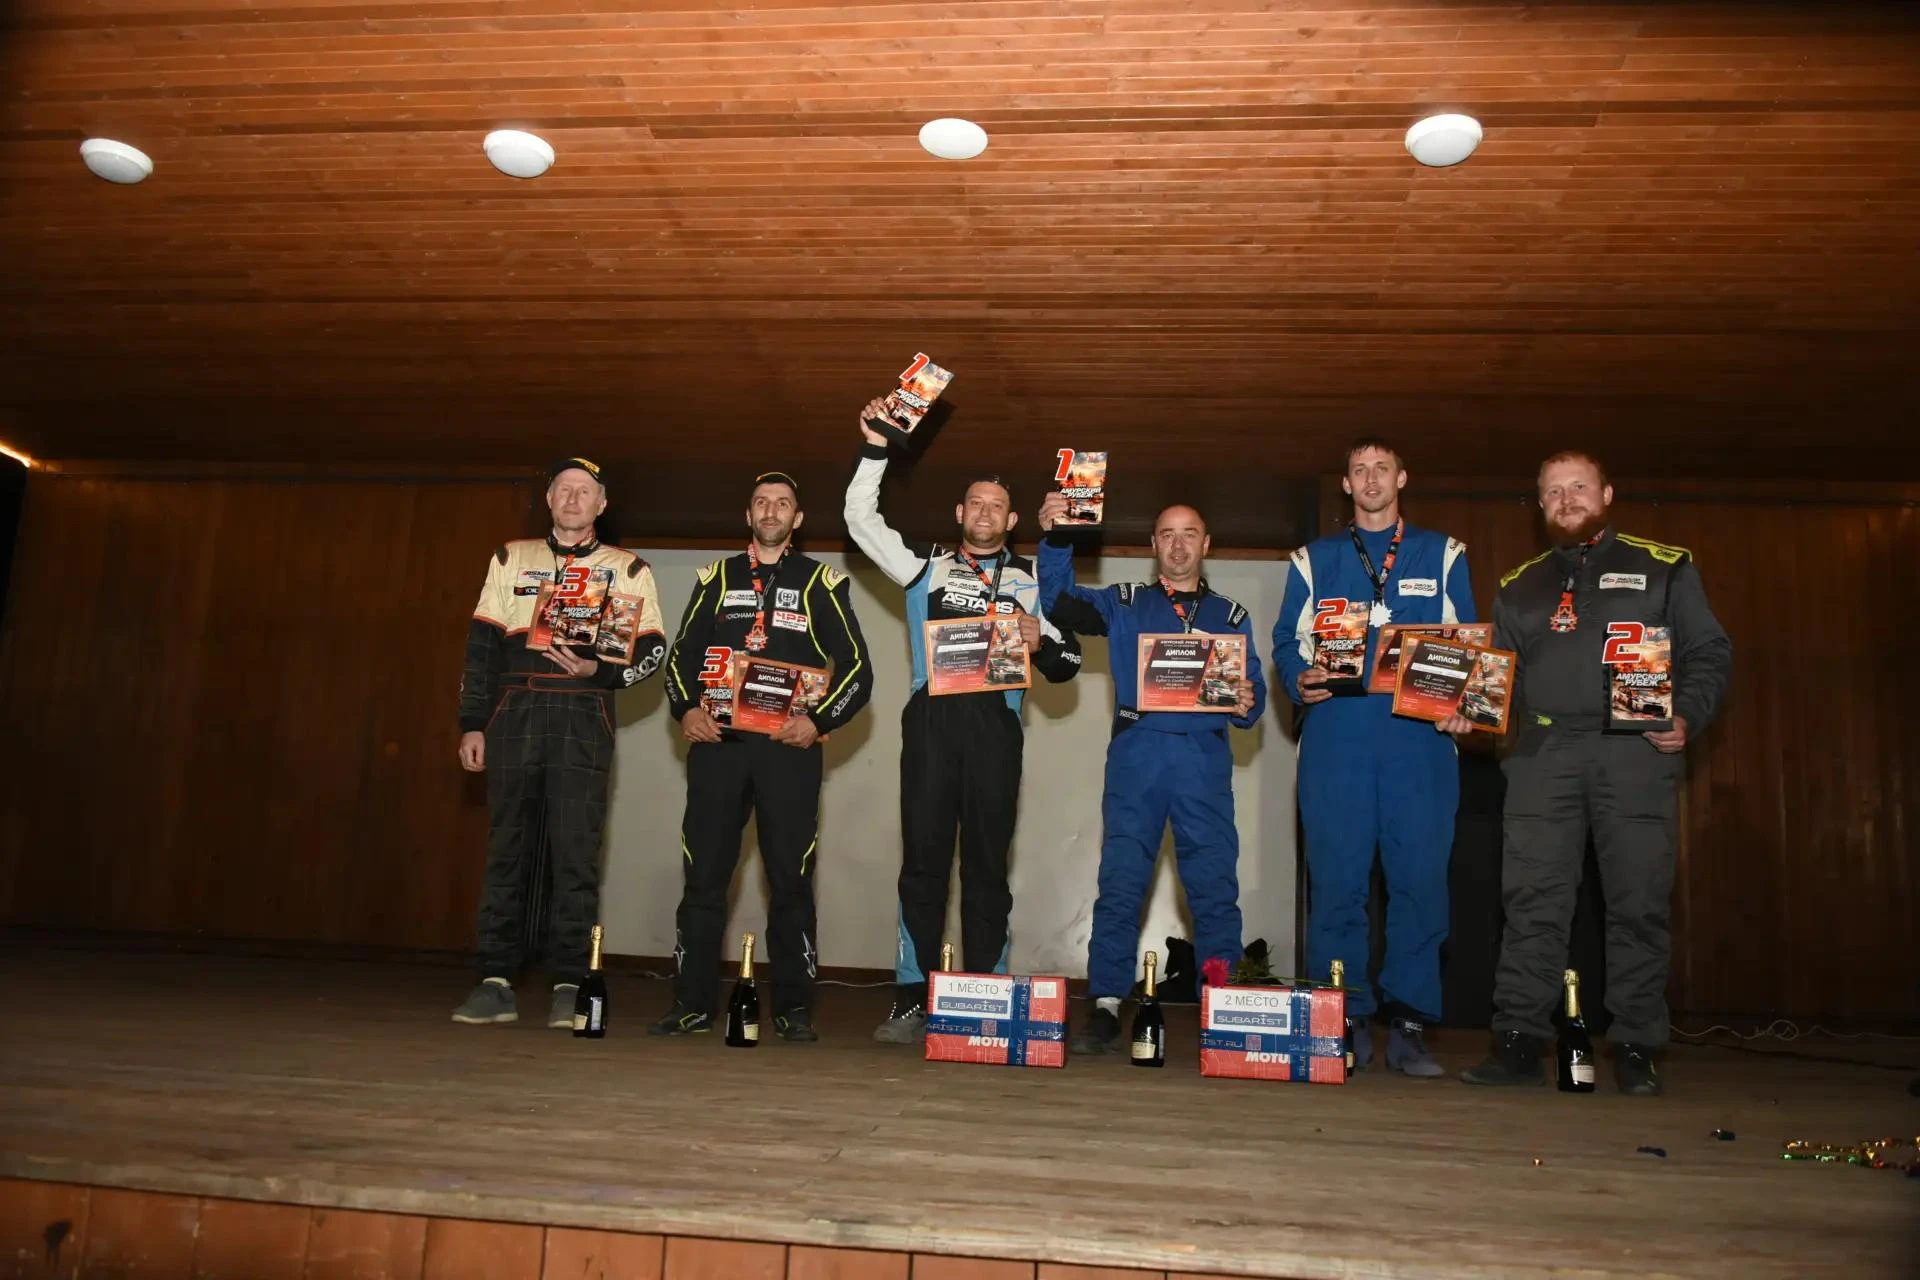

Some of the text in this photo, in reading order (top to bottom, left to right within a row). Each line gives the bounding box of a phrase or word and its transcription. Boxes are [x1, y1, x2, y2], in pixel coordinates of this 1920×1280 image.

[899, 352, 930, 382] 1
[1055, 448, 1075, 480] 1
[555, 566, 592, 599] 3
[942, 592, 1015, 614] ASTAS
[1311, 597, 1349, 633] 2
[950, 632, 979, 640] ДИПЛОМ
[1602, 621, 1645, 664] 2
[698, 646, 733, 680] 3
[1427, 653, 1460, 665] ДИПЛОМ
[757, 674, 785, 683] ДИПЛОМ
[1616, 672, 1668, 681] АМУРСКИЙ
[704, 688, 733, 696] АМУРСК
[957, 982, 999, 995] МЕСТО
[941, 1000, 1005, 1012] SUBARIST
[1225, 994, 1232, 1005] 2
[1235, 996, 1279, 1007] МЕСТО
[1216, 1013, 1283, 1025] SUBARIST
[968, 1036, 1009, 1047] MOTU
[1245, 1051, 1291, 1064] MOTU
